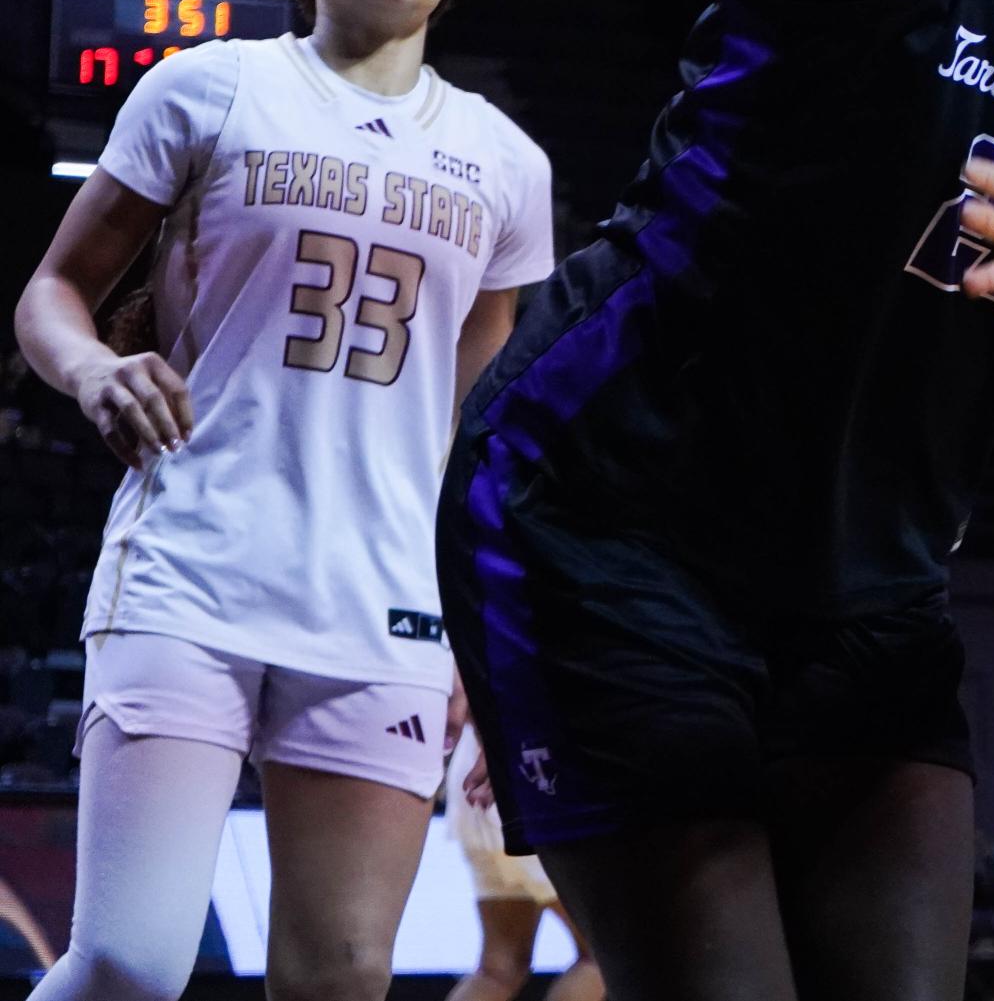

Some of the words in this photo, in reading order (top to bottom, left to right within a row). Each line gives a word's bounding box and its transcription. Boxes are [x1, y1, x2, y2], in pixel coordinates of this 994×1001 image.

[244, 151, 369, 216] TEXAS
[382, 172, 483, 259] STATE
[283, 230, 425, 386] 33
